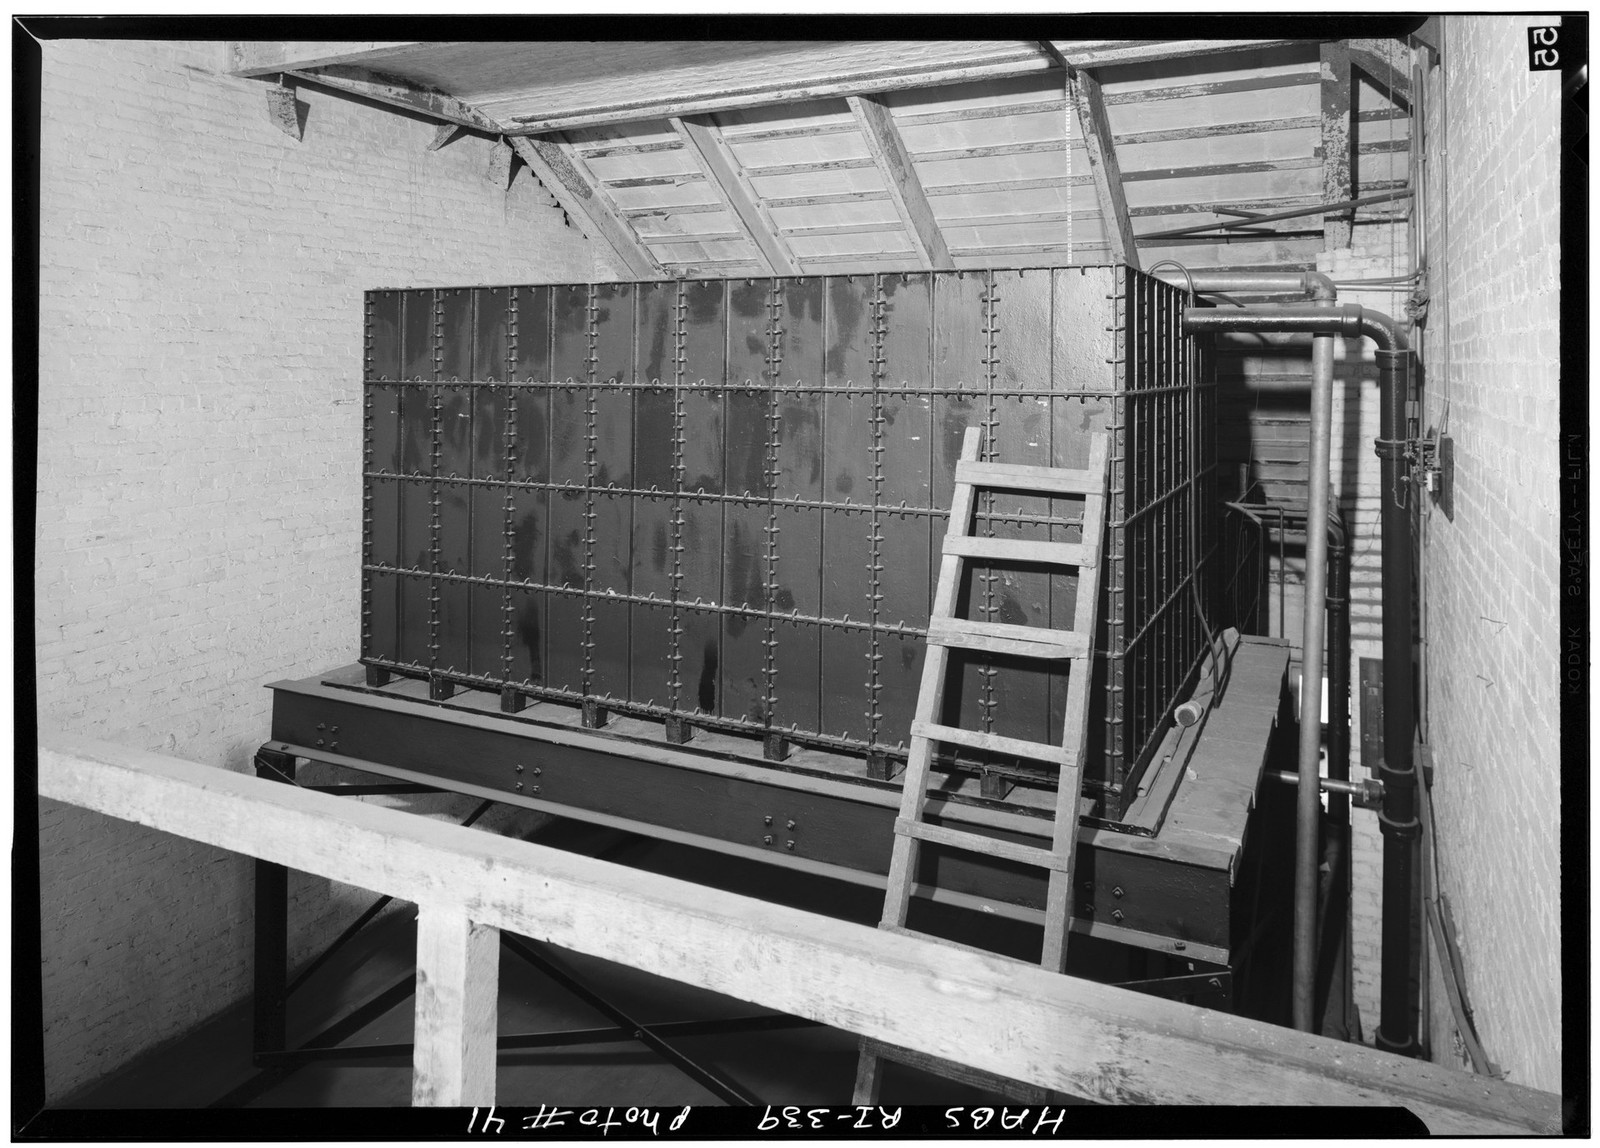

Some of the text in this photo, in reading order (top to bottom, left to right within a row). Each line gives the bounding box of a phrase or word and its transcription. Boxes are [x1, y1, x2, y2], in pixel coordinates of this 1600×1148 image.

[466, 1106, 506, 1134] 41
[756, 1105, 902, 1130] RI-339
[944, 1105, 1066, 1134] HABS
